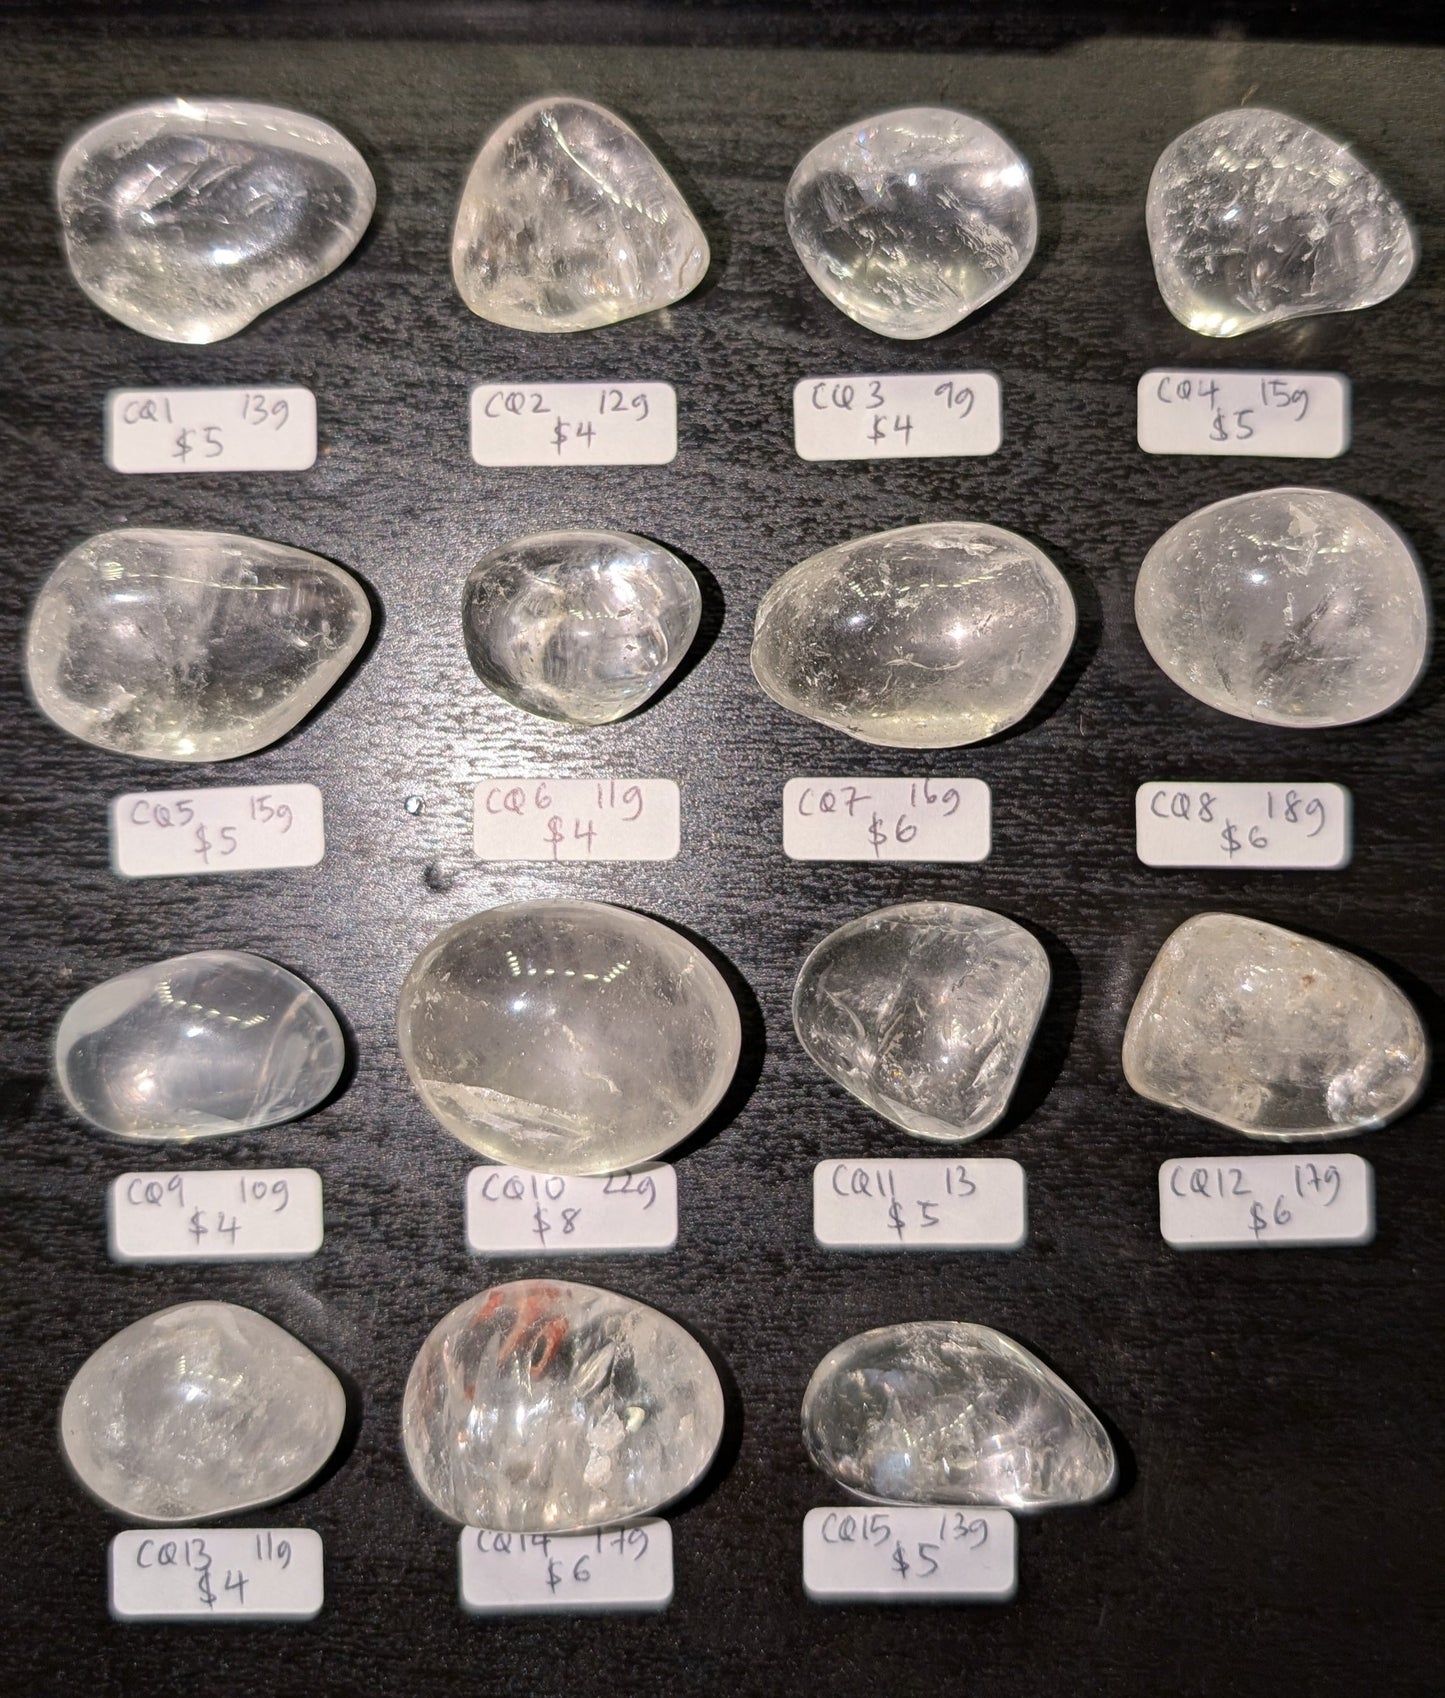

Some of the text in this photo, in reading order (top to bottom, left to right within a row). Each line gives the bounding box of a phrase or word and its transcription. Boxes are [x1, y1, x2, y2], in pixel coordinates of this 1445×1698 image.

[122, 393, 289, 431] CQ1 13g
[484, 388, 650, 422] CQ2 12g
[811, 380, 975, 420] CQ3 9g
[1156, 376, 1310, 422] CQ4 15g
[130, 795, 294, 834] CQ5 15g
[485, 780, 644, 822] CQ6 11g
[798, 782, 961, 818] CQ7 16g
[1150, 789, 1326, 838] CQ8 18g
[125, 1175, 289, 1213] CQ9 10g
[481, 1172, 566, 1202] CQ10
[831, 1163, 977, 1198] CQ11 13
[1169, 1162, 1342, 1207] CQ12 17g
[821, 1511, 989, 1550] CQ15 13g
[136, 1531, 292, 1572] CQ13 11g
